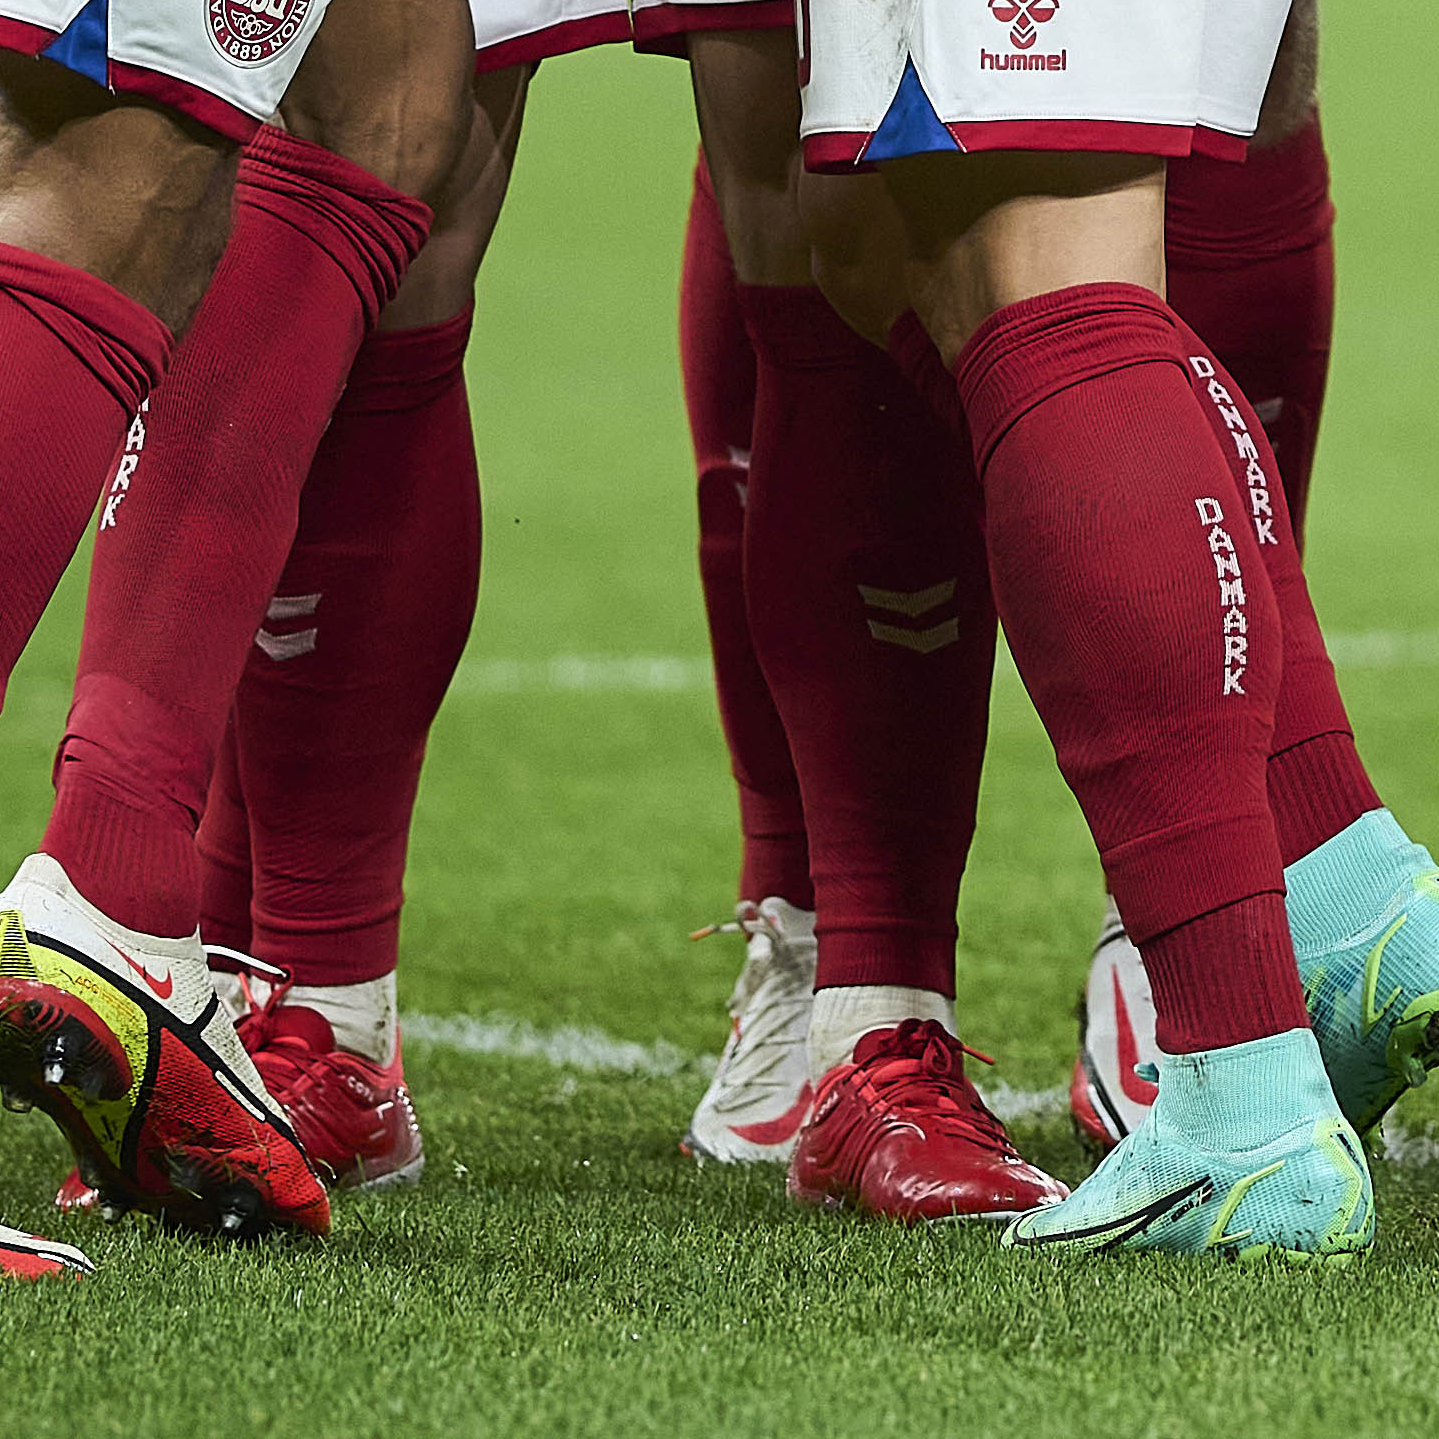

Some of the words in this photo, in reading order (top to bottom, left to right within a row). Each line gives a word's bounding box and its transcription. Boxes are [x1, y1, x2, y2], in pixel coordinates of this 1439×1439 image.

[222, 35, 262, 60] 1889
[980, 48, 1067, 71] hummel
[1189, 356, 1278, 545] DANMARK
[1195, 498, 1247, 696] DANMARK
